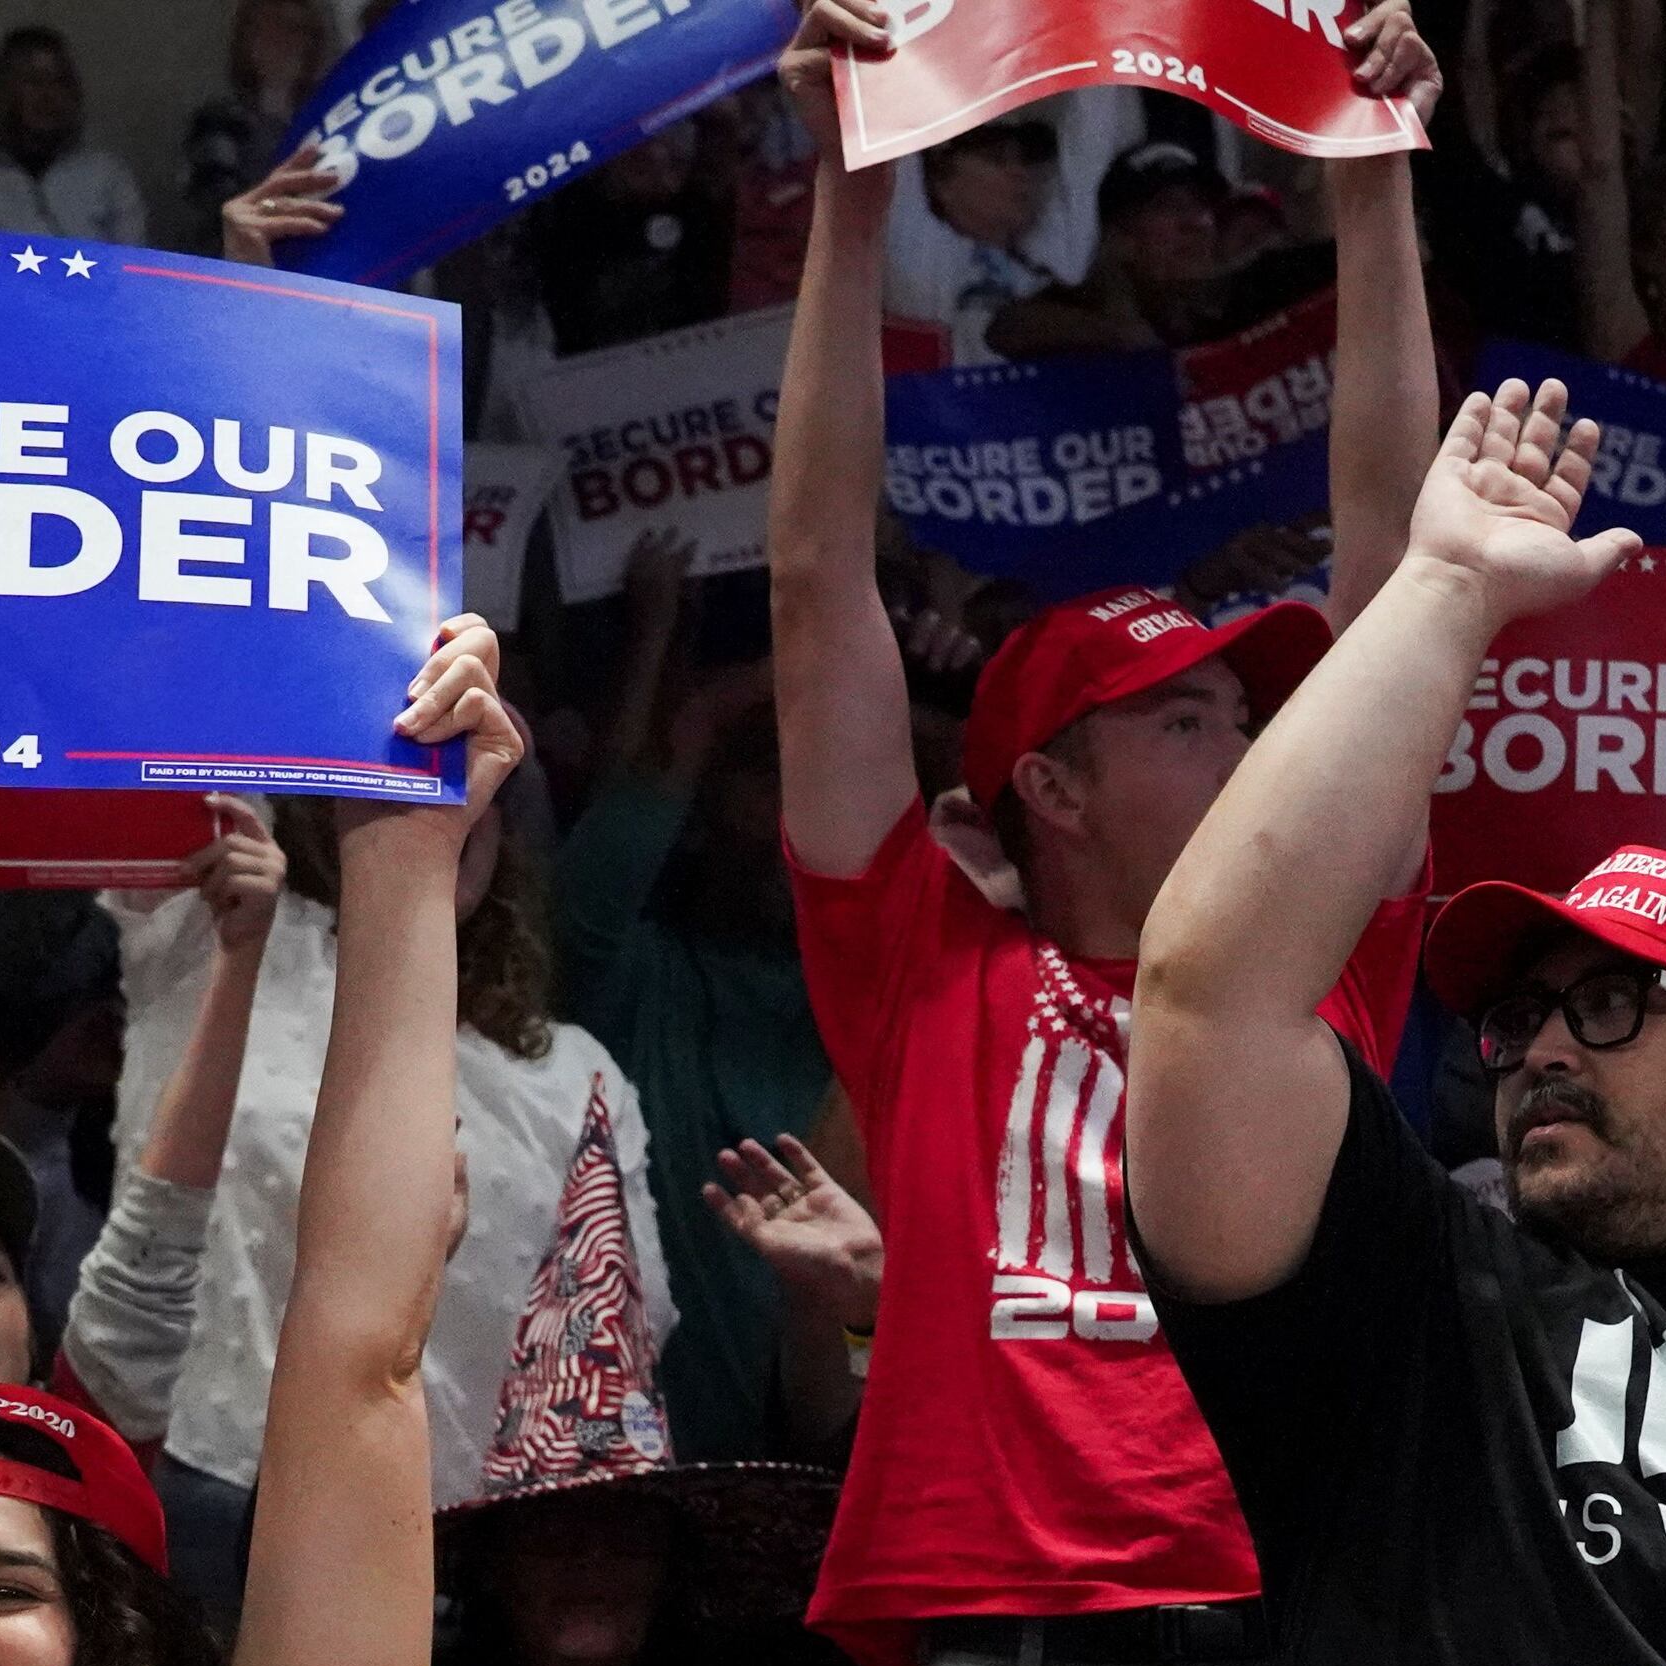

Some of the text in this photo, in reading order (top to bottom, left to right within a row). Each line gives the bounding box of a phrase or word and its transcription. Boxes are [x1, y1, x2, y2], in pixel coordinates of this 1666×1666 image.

[305, 0, 543, 150] ECURE
[311, 0, 688, 198] BORDE
[1111, 49, 1207, 92] 2024
[505, 141, 591, 202] 2024
[108, 411, 384, 513] OUR
[564, 394, 747, 474] SECURE
[1051, 425, 1155, 466] OUR
[149, 767, 175, 777] PAID
[175, 768, 198, 777] FOR
[198, 768, 213, 777] BY
[214, 769, 258, 779] DONALD
[269, 771, 305, 781] TRUMP
[306, 772, 327, 782] FOR
[328, 773, 384, 786] PRESIDENT
